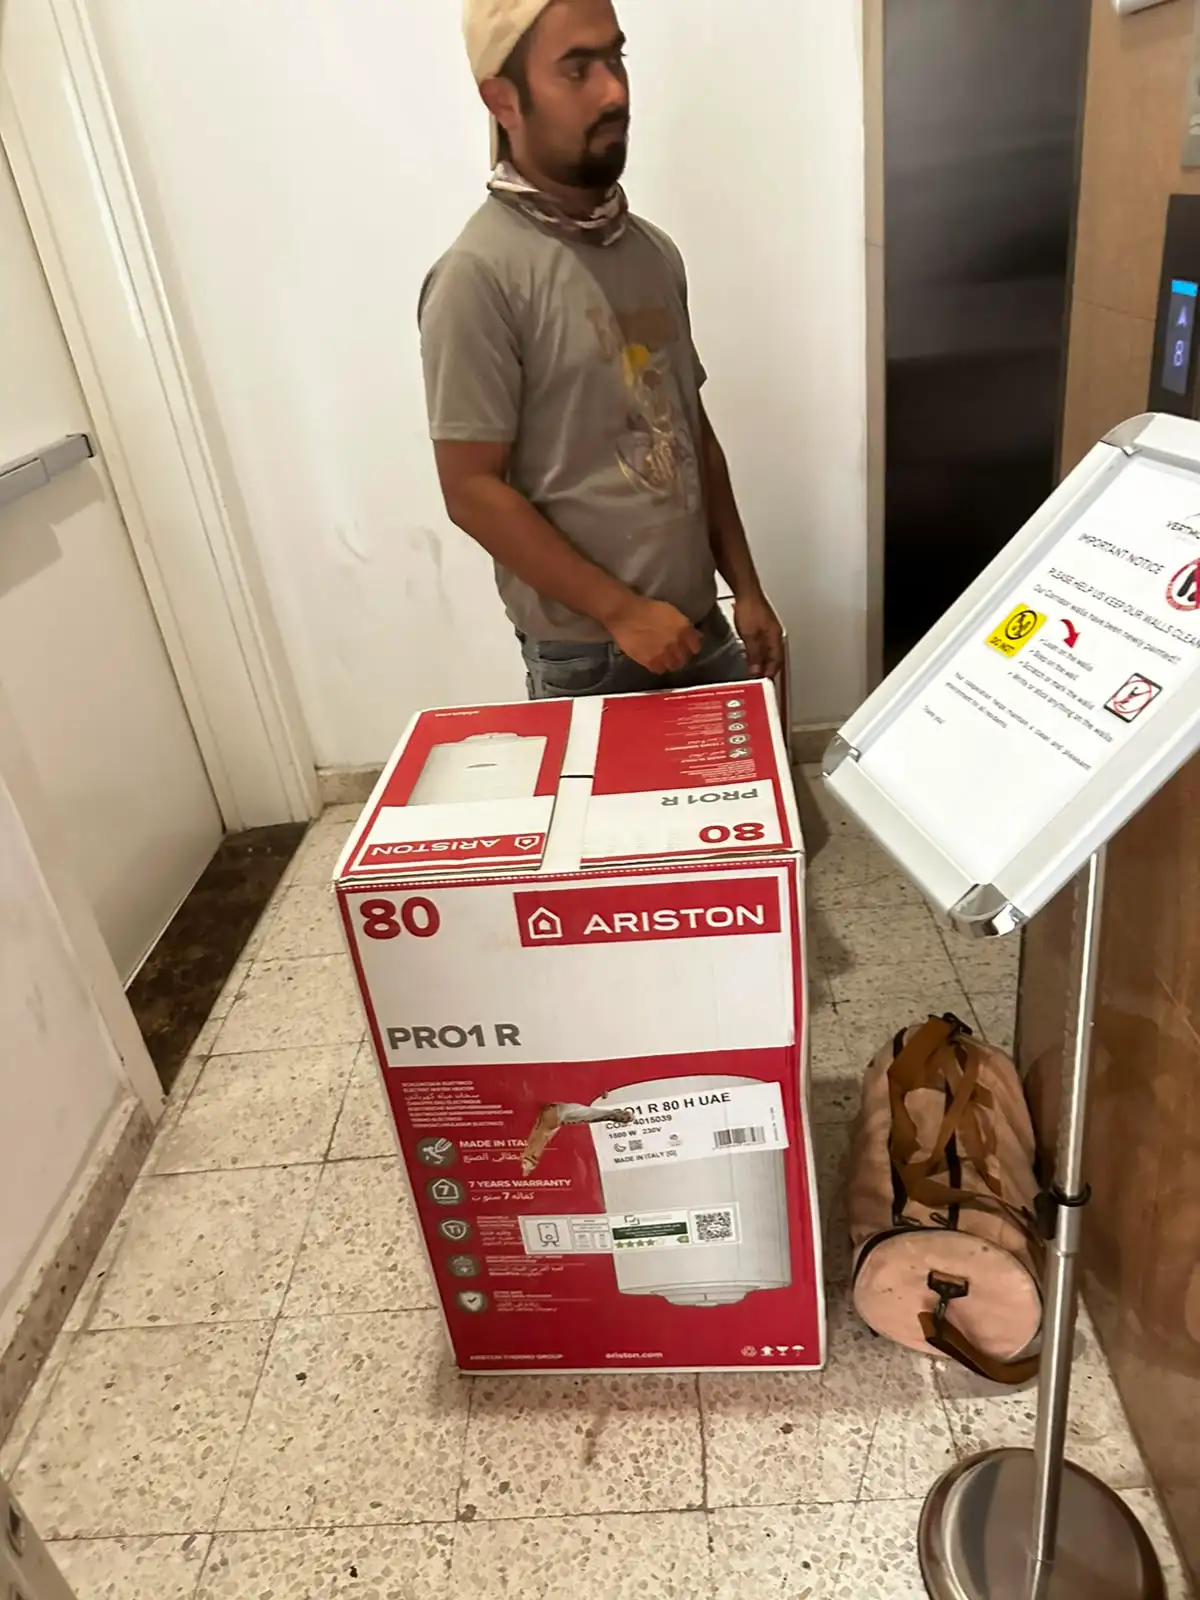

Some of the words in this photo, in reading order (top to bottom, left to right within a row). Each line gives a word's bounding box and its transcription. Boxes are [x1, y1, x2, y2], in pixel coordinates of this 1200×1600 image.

[1173, 340, 1185, 367] 8
[1079, 533, 1128, 558] IMPORTANT
[1127, 553, 1164, 575] NOTICE
[1048, 567, 1075, 584] PLEASE
[1074, 580, 1094, 593] HELP
[1092, 586, 1106, 600] US
[1104, 595, 1126, 609] KEEP
[1123, 604, 1144, 619] OUR
[1142, 615, 1174, 633] WALLS
[1070, 604, 1089, 617] walls
[1087, 613, 1106, 625] have
[1105, 622, 1123, 634] been
[1123, 631, 1144, 648] newly
[989, 636, 1002, 647] DO
[999, 641, 1016, 653] NOT
[661, 796, 679, 806] R
[688, 788, 759, 805] PRO1
[699, 822, 765, 844] 80
[371, 838, 501, 856] ARISTON
[359, 896, 441, 940] 80
[583, 905, 764, 936] ARISTON
[387, 1024, 485, 1050] PRO1
[495, 1023, 521, 1047] R
[648, 1103, 659, 1114] R
[663, 1101, 680, 1112] 80
[684, 1098, 695, 1109] H
[699, 1092, 731, 1106] UAE
[633, 1114, 672, 1127] 4015039
[460, 1140, 492, 1148] MADE
[493, 1139, 505, 1147] IN
[507, 1138, 529, 1147] ITAL
[614, 1155, 635, 1164] MADE
[636, 1154, 644, 1162] IN
[644, 1152, 664, 1161] ITALY
[438, 1185, 450, 1196] 7
[468, 1180, 476, 1188] 7
[477, 1180, 511, 1188] YEARS
[511, 1179, 571, 1187] WARRANTY
[605, 1351, 664, 1359] ariston.com
